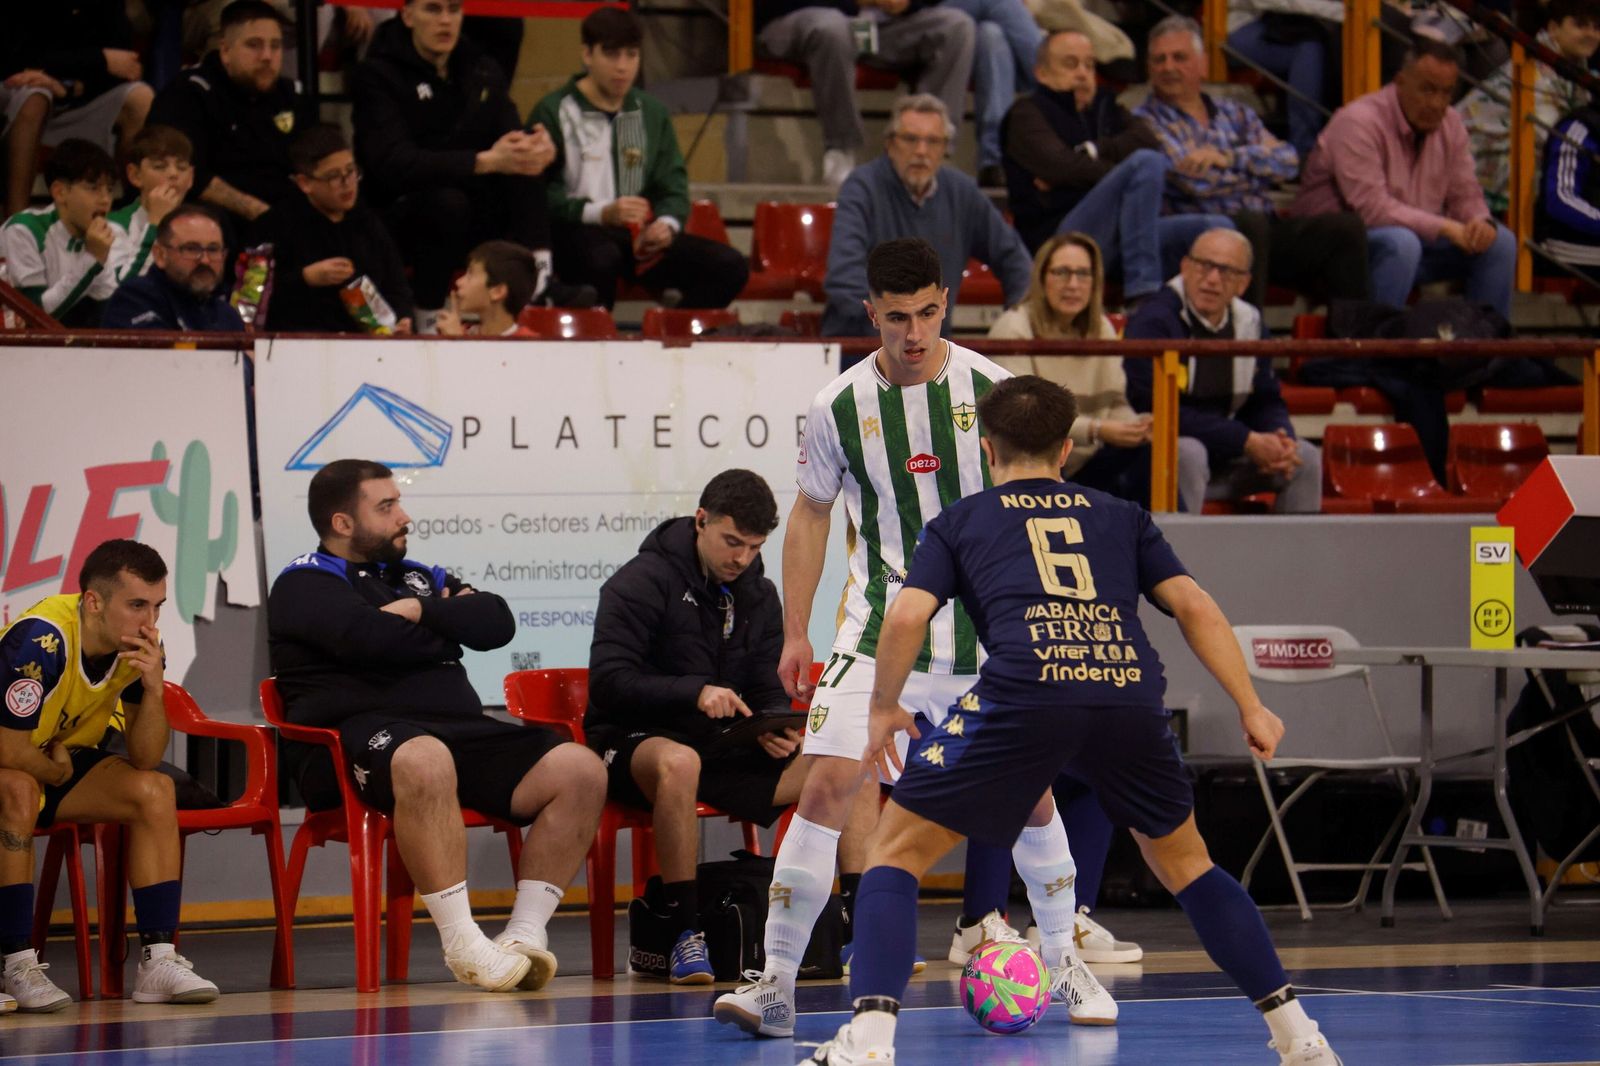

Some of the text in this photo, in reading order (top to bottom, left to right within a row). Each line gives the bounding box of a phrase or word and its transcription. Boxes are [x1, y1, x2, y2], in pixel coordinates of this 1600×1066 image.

[1000, 493, 1092, 509] NOVOA
[408, 515, 482, 540] ogados
[501, 513, 590, 535] Gestores
[595, 512, 677, 533] Admin
[1025, 517, 1097, 600] 6
[1479, 546, 1507, 559] SV
[483, 560, 621, 581] Administrado
[519, 610, 595, 627] RESPONS
[1093, 644, 1138, 661] KOA
[1268, 642, 1333, 658] IMDECO
[817, 651, 857, 688] 27
